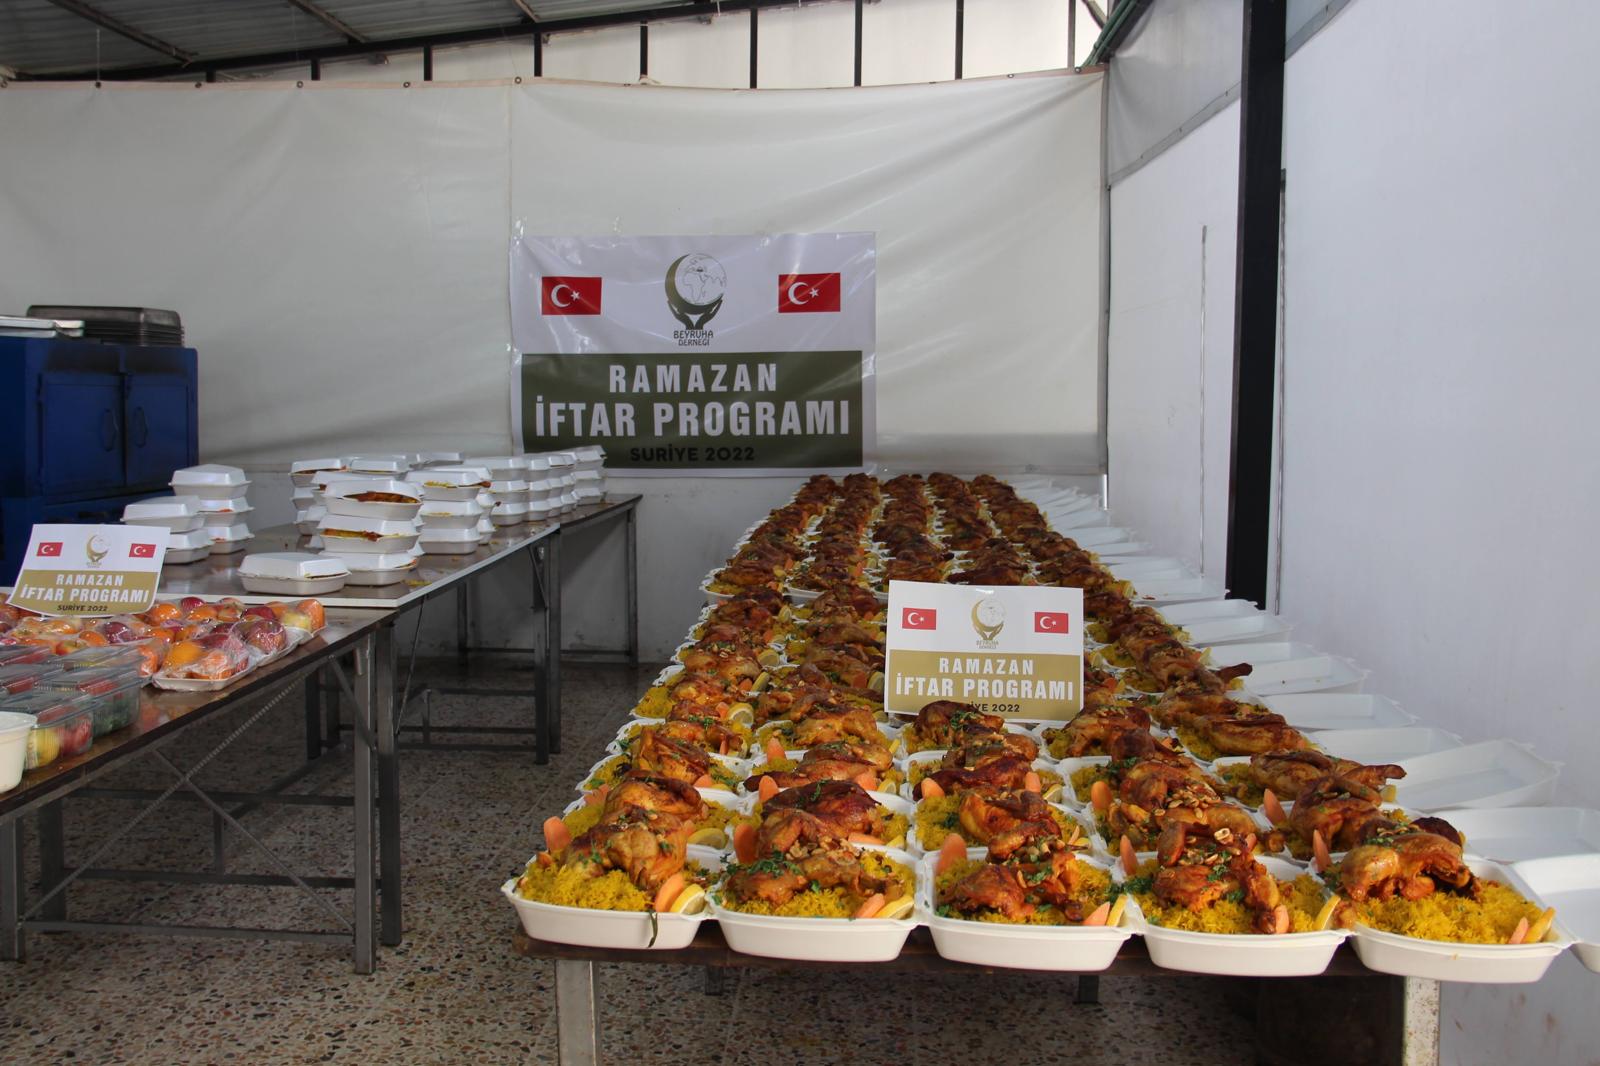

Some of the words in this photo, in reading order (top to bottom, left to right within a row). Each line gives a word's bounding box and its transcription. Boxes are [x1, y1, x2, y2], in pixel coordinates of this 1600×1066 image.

[673, 330, 713, 339] BEYRUHA
[609, 363, 777, 393] RAMAZAN
[535, 395, 635, 437] İFTAR
[653, 400, 849, 437] PROGRAMI
[630, 443, 699, 462] SURİYE
[705, 446, 755, 461] 2022
[56, 574, 124, 586] RAMAZAN
[20, 584, 64, 601] İFTAR
[70, 588, 149, 604] PROGRAMI
[57, 603, 85, 612] SURİYE
[939, 657, 1034, 675] RAMAZAN
[896, 672, 953, 697] İFTAR
[963, 678, 1074, 701] PROGRAMI
[991, 703, 1020, 713] 2022
